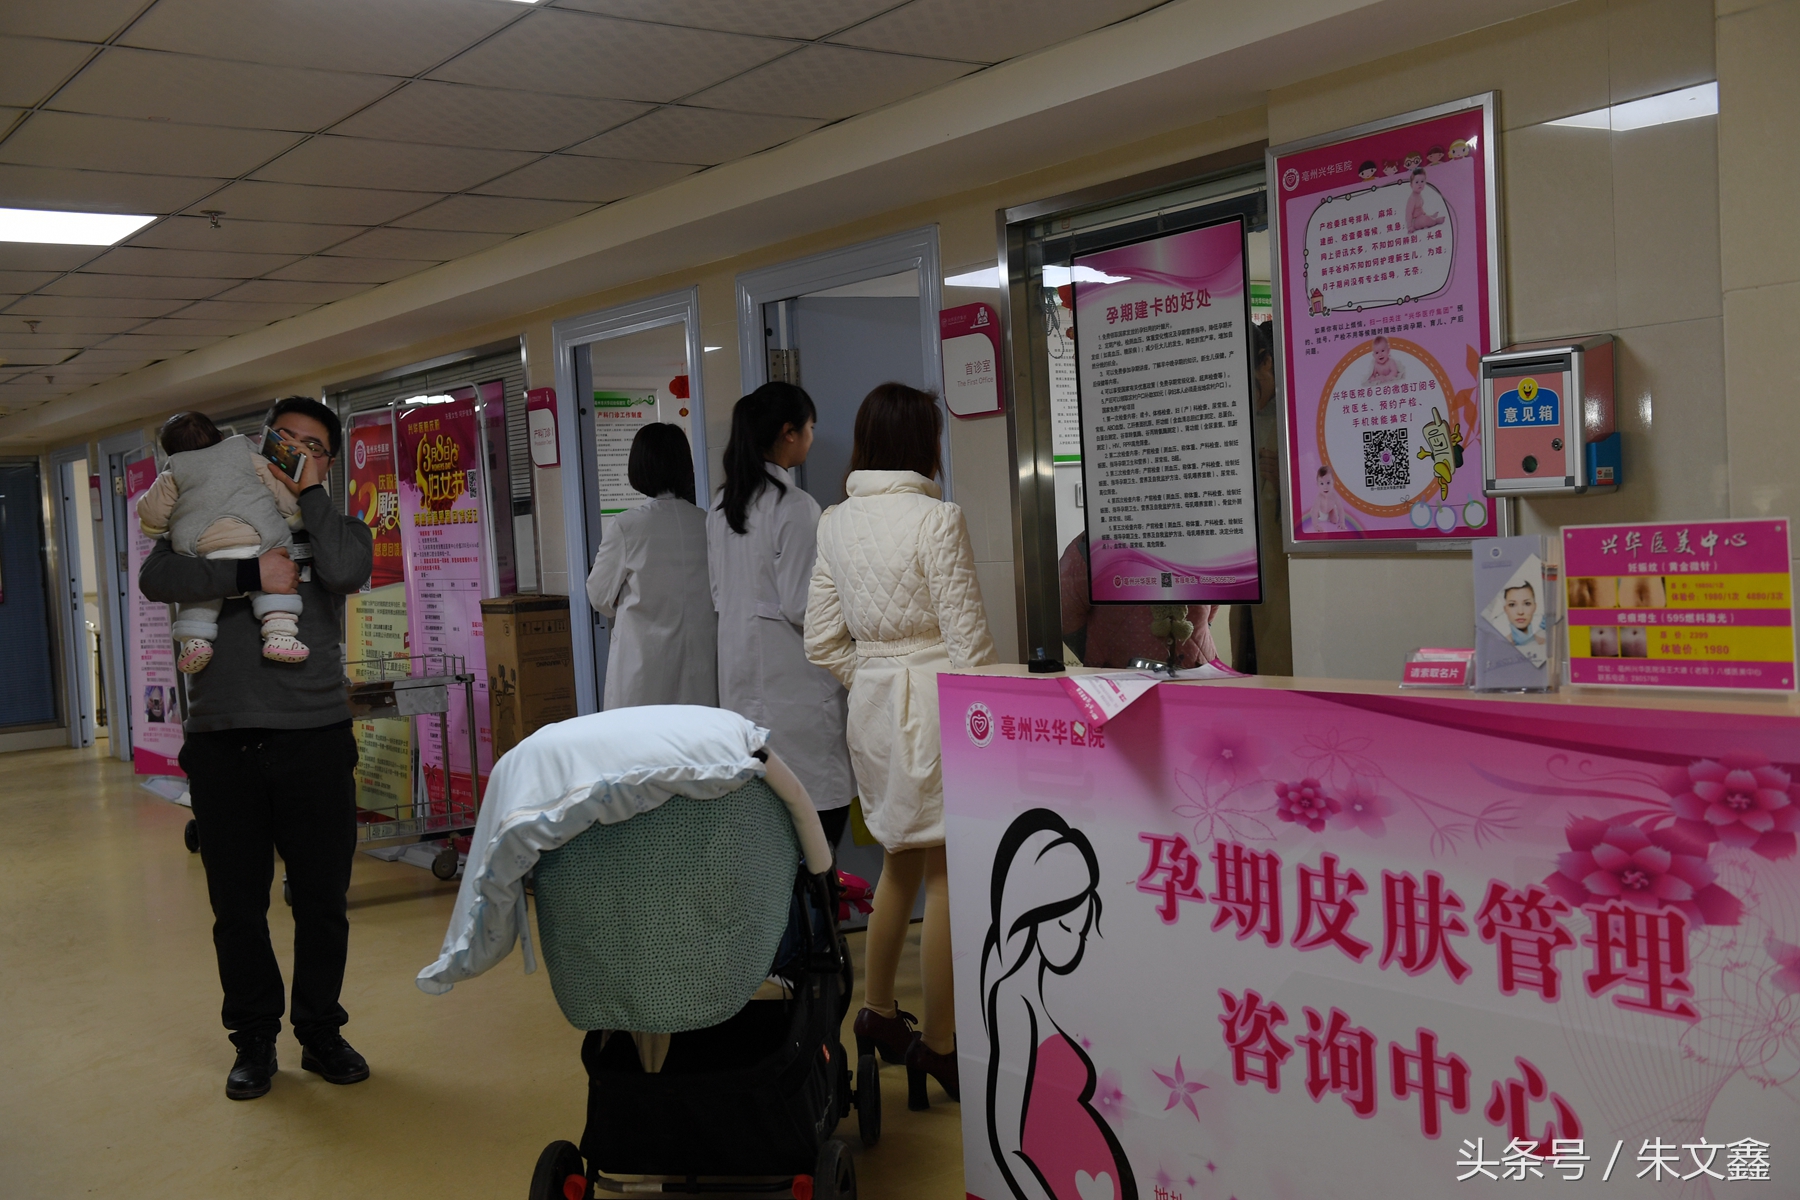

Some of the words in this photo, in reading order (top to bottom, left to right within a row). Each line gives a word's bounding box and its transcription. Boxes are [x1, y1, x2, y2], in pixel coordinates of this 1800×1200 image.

[1300, 159, 1352, 182] 亳州兴华医院
[1106, 287, 1211, 324] 孕期建卡的好处
[1305, 346, 1319, 355] 问题。
[965, 359, 992, 376] 首诊室
[966, 378, 978, 386] First
[979, 375, 994, 385] Office
[1332, 379, 1436, 401] 兴华医院自己的微信订阅号
[1352, 412, 1413, 427] 手机就能搞定！
[1503, 404, 1553, 423] 意见箱
[366, 443, 389, 455] 亳州兴华医院
[422, 434, 451, 472] 3月8日
[428, 470, 465, 502] 妇女节
[1600, 529, 1748, 558] 兴华医美中心
[1136, 831, 1701, 1023] 孕期皮肤管理
[1218, 986, 1584, 1162] 咨询中心
